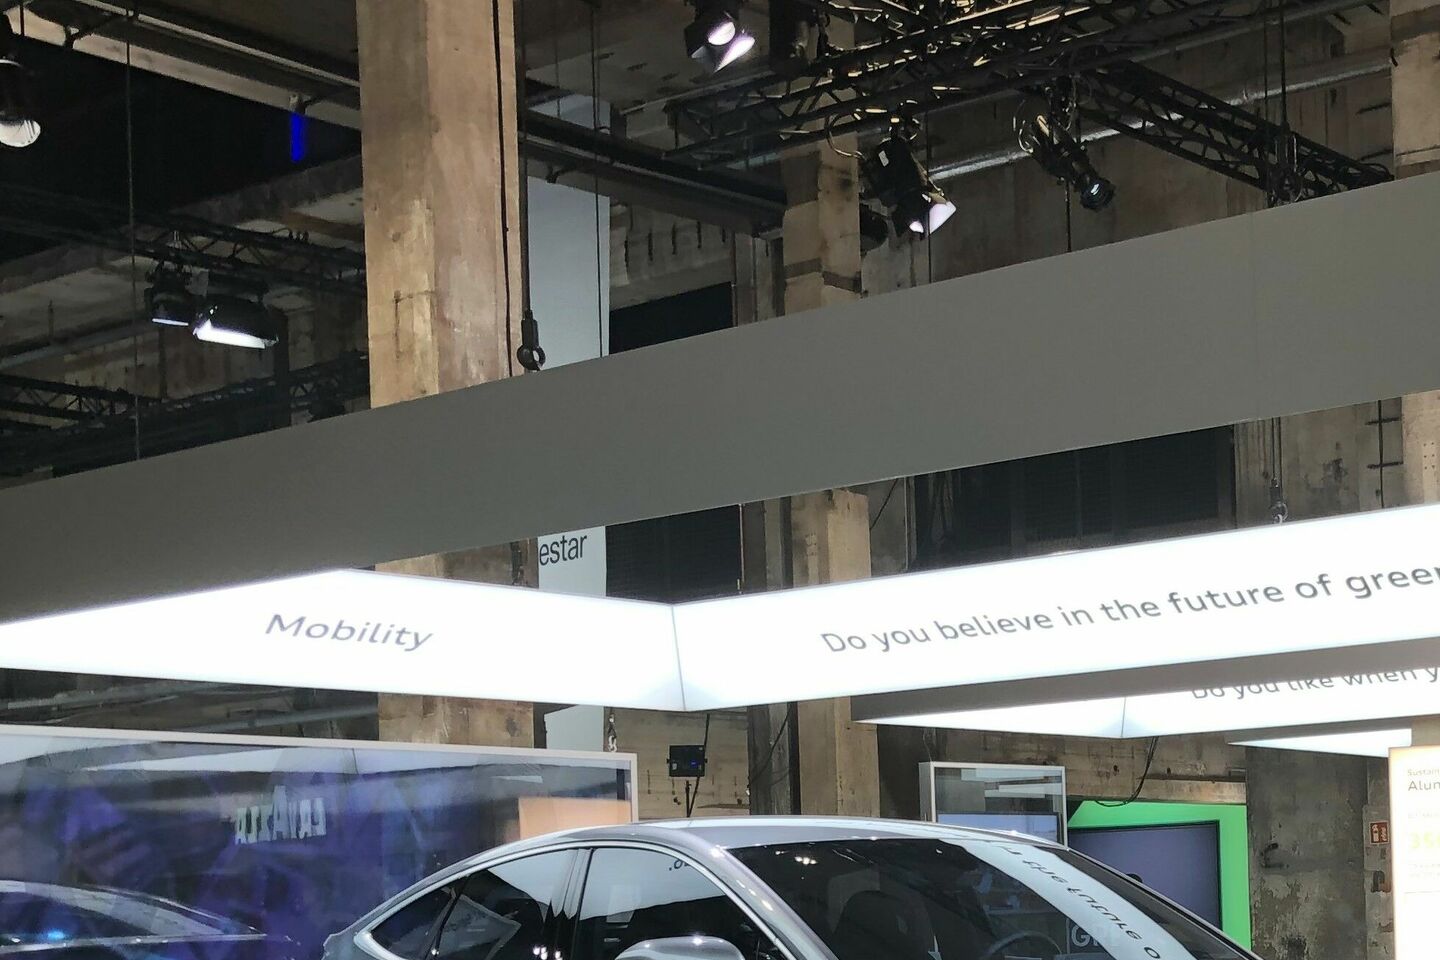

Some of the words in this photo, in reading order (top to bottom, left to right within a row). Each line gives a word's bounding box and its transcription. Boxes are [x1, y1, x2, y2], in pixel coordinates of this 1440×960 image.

[265, 614, 432, 652] Mobility
[822, 633, 867, 652] Do
[871, 628, 930, 653] you
[933, 614, 1054, 640] believe
[1060, 606, 1093, 626] in
[1099, 600, 1161, 622] the
[1167, 586, 1285, 614] future
[1294, 574, 1332, 599] of
